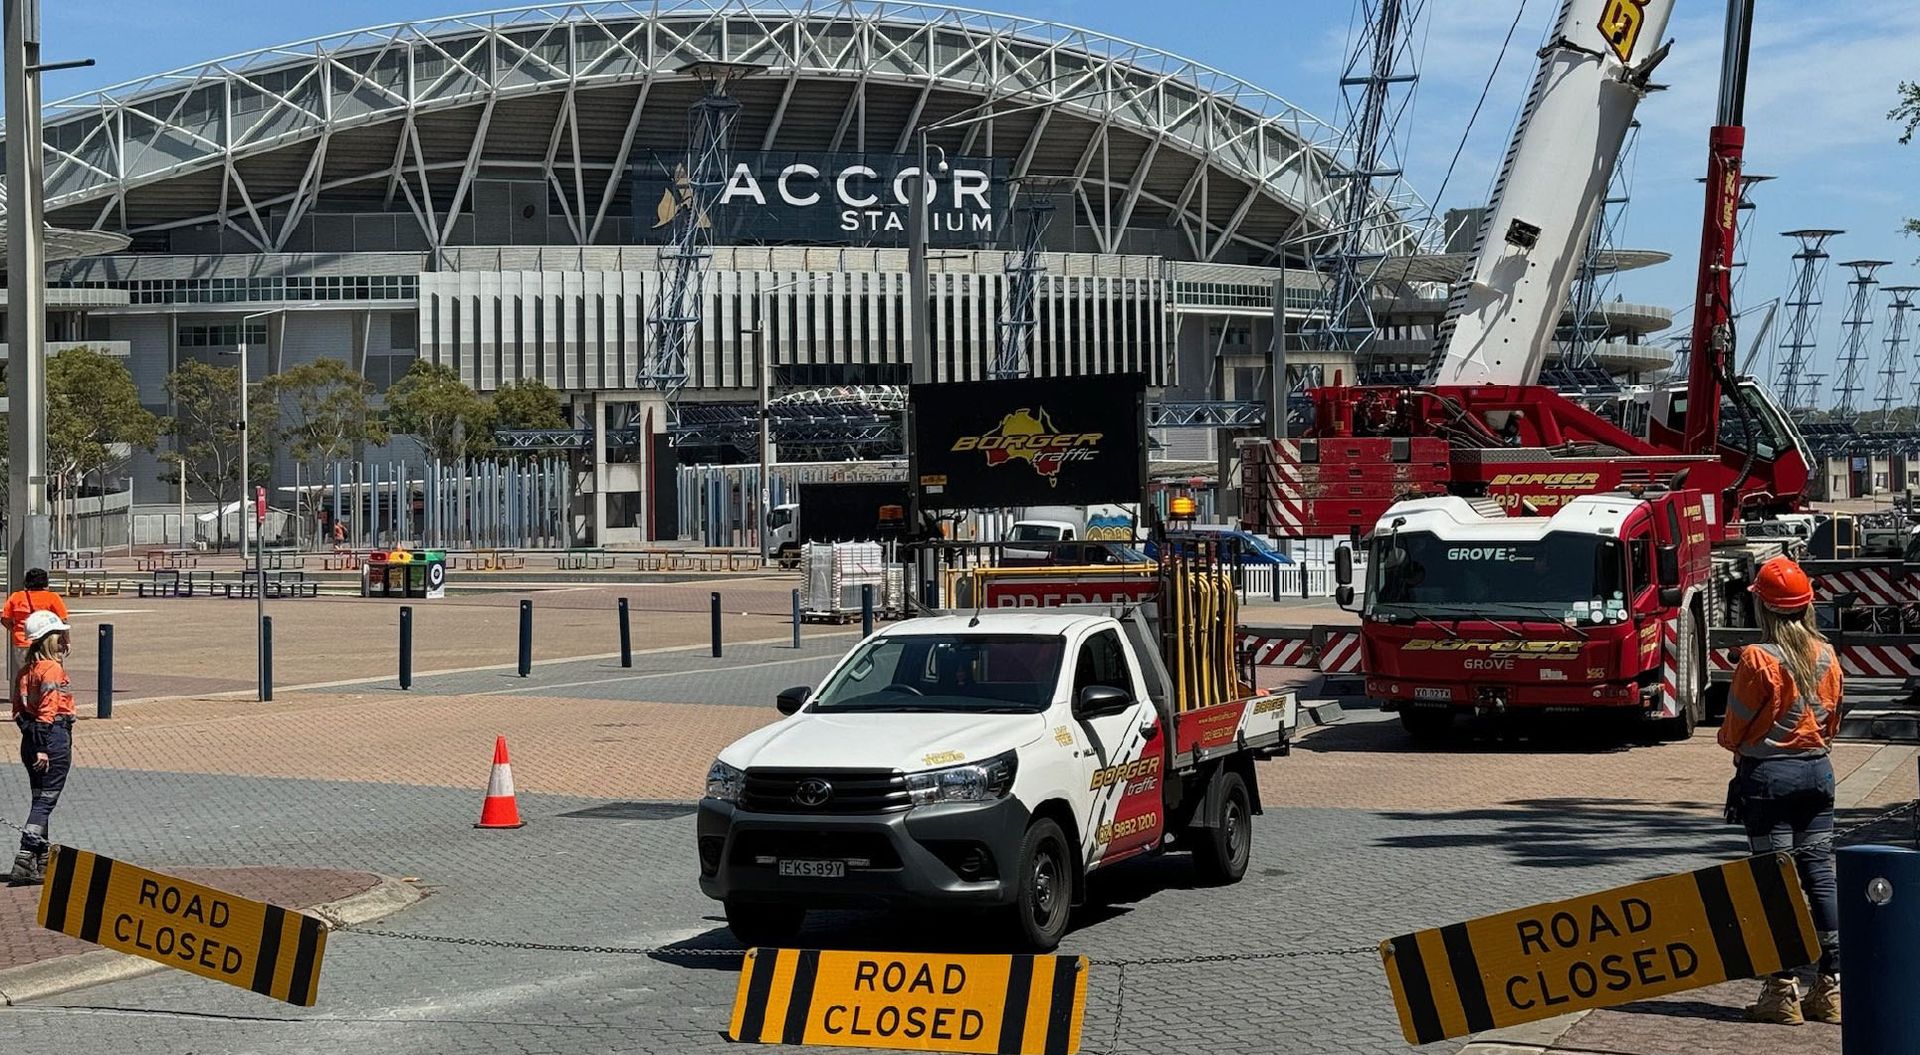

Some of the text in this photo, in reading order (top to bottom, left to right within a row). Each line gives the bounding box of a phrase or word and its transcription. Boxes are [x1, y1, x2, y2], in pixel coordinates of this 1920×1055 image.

[719, 162, 992, 210] ACCOR
[840, 210, 992, 232] STAIUM
[951, 432, 1104, 452] BORGER
[1033, 446, 1100, 463] traffic
[1490, 472, 1601, 486] BORGER
[1447, 547, 1507, 561] GROVE
[1402, 638, 1583, 654] BORGER
[1463, 658, 1516, 671] GROVE
[1090, 755, 1160, 791] BORGER
[1127, 776, 1159, 796] traffic
[1113, 818, 1137, 840] 9832
[1137, 812, 1158, 834] 1200
[138, 878, 230, 929] ROAD
[1516, 897, 1653, 955] ROAD
[114, 913, 243, 975] CLOSED
[854, 960, 967, 995] ROAD
[1505, 942, 1699, 1011] CLOSED
[823, 1005, 985, 1041] CLOSED
